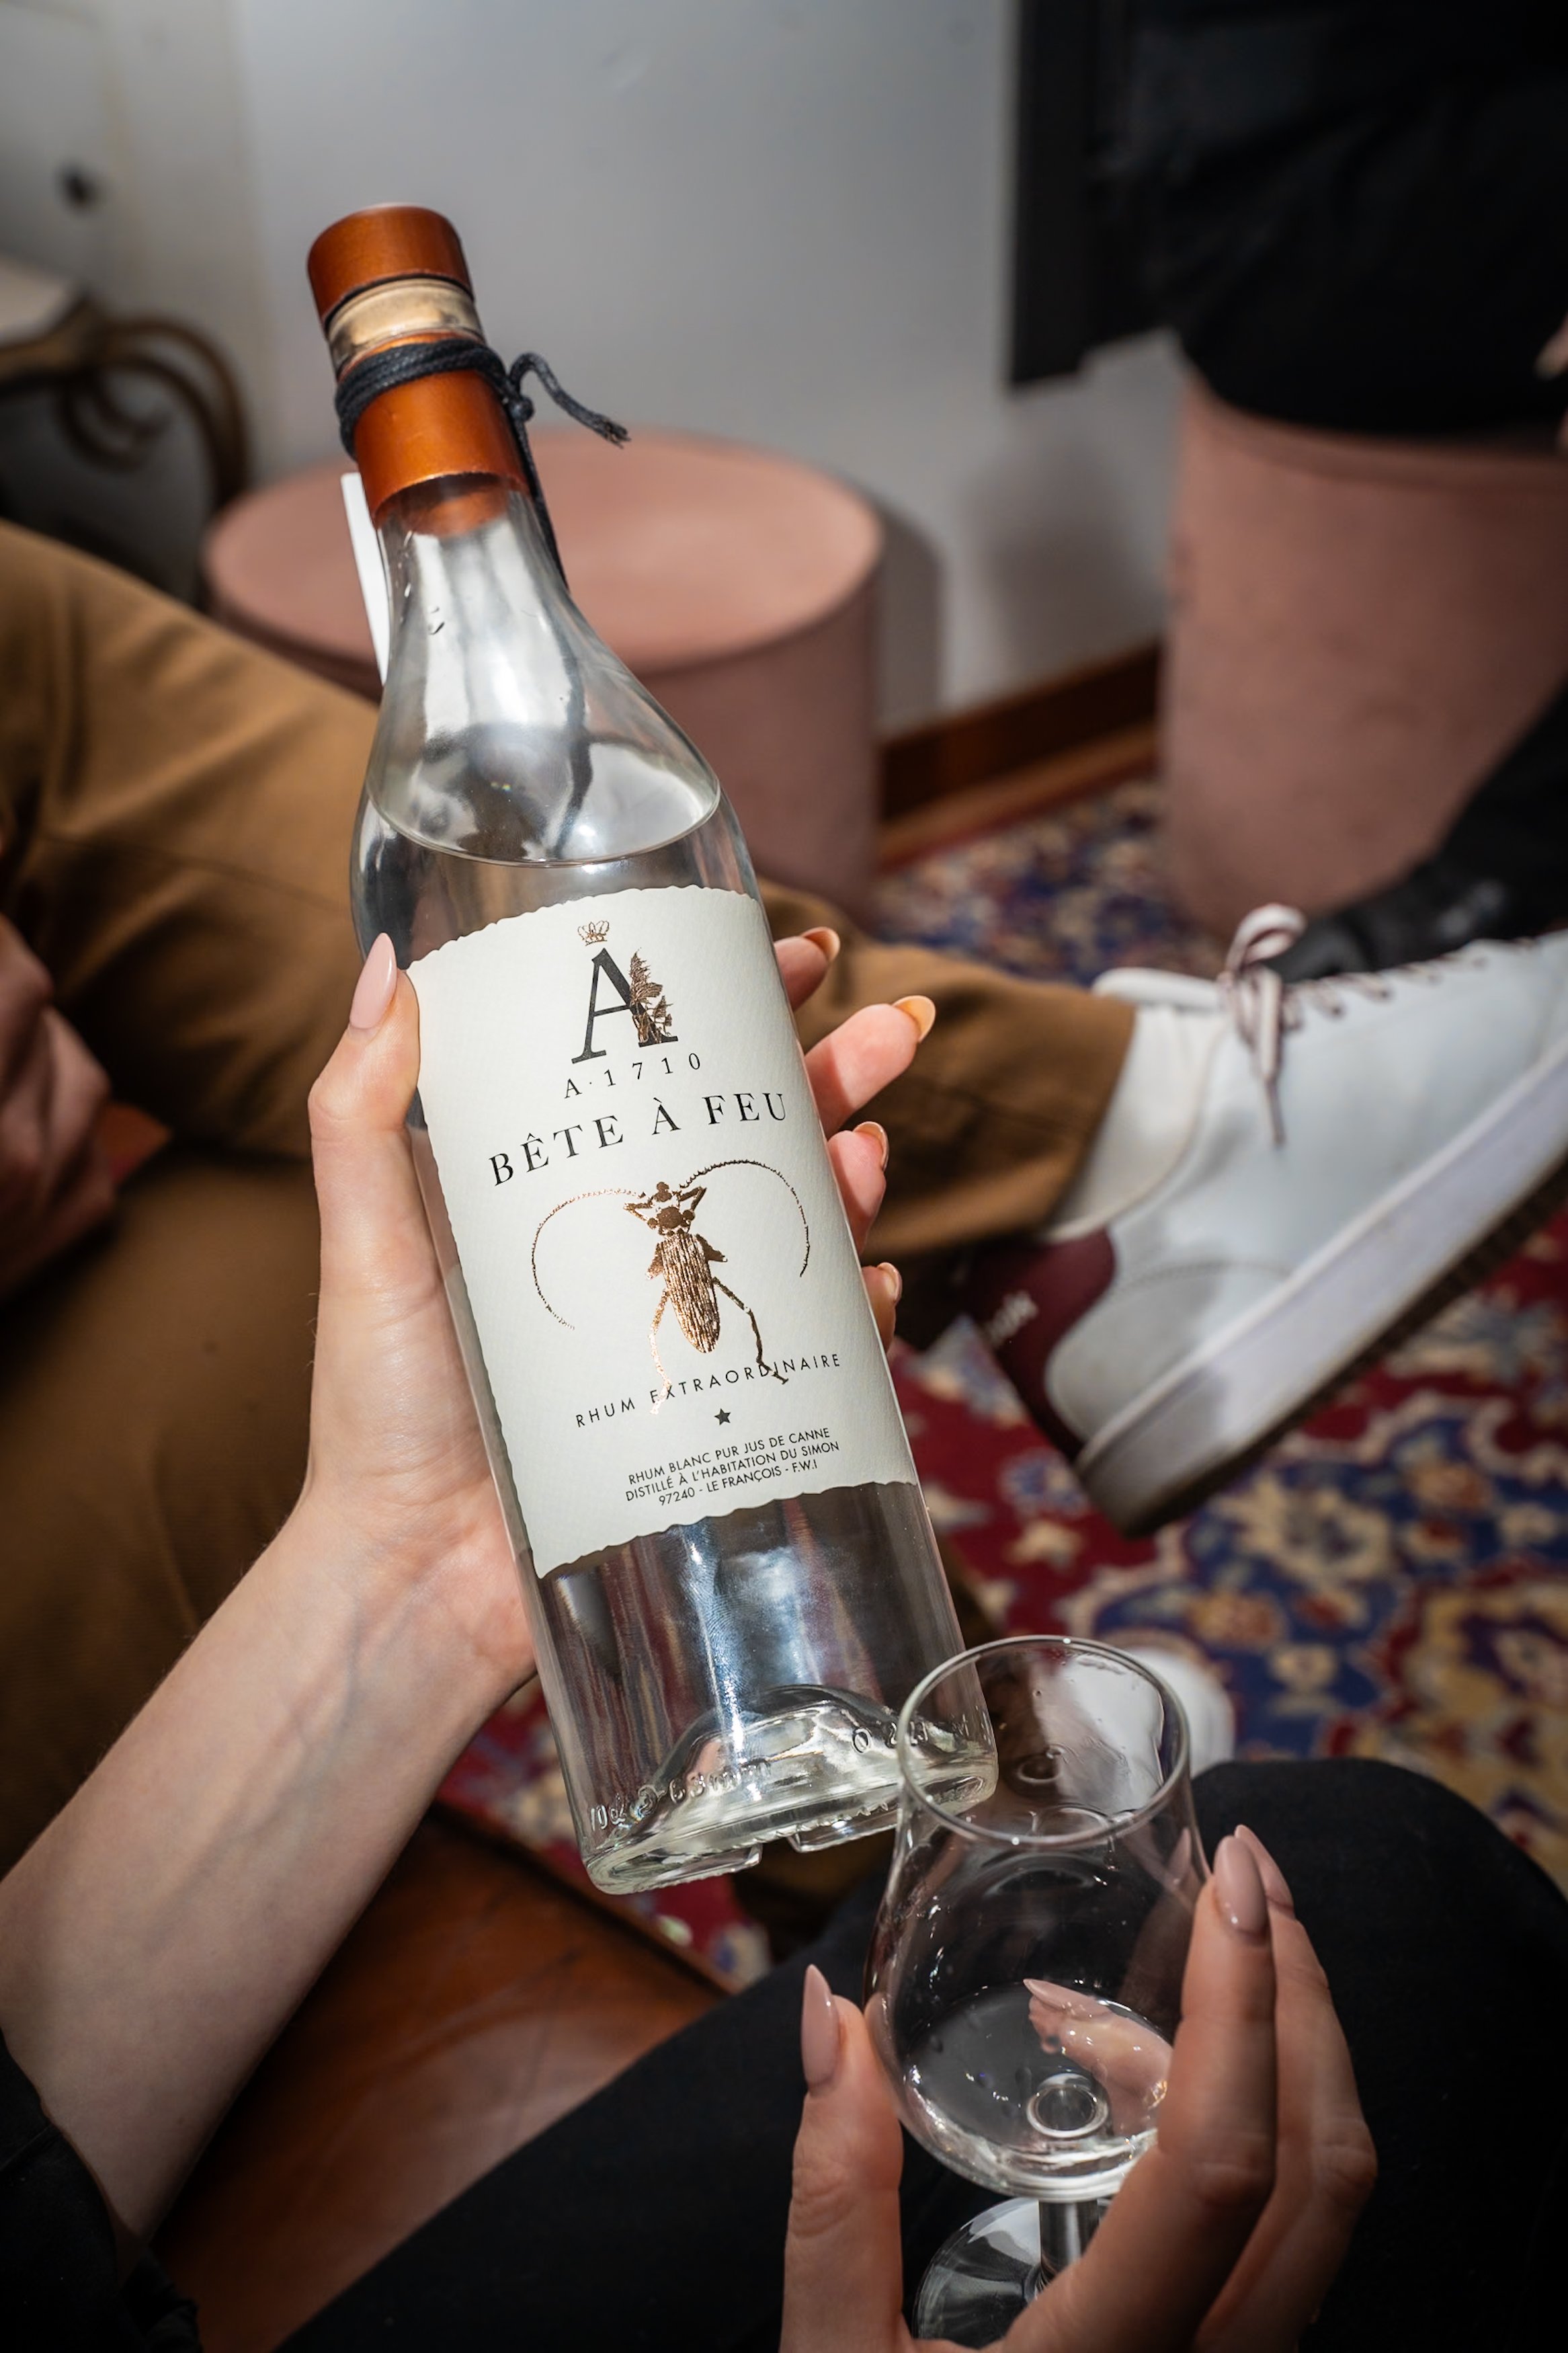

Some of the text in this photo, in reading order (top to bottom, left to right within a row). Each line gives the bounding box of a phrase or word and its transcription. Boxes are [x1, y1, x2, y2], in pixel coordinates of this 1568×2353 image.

[571, 947, 679, 1064] A
[488, 1092, 786, 1187] BÊTE À FEU
[575, 1353, 841, 1428] RHUM EXTRAORDINAIRE
[626, 1441, 839, 1501] DISTILLÉ À L'HABITATION DU SIMON
[628, 1427, 830, 1485] RHUM BLANC PUR JUS DE CANNE
[659, 1487, 695, 1506] 97240
[706, 1480, 719, 1492] LE
[722, 1466, 782, 1488] FRANÇOIS
[792, 1459, 818, 1473] F.W.I
